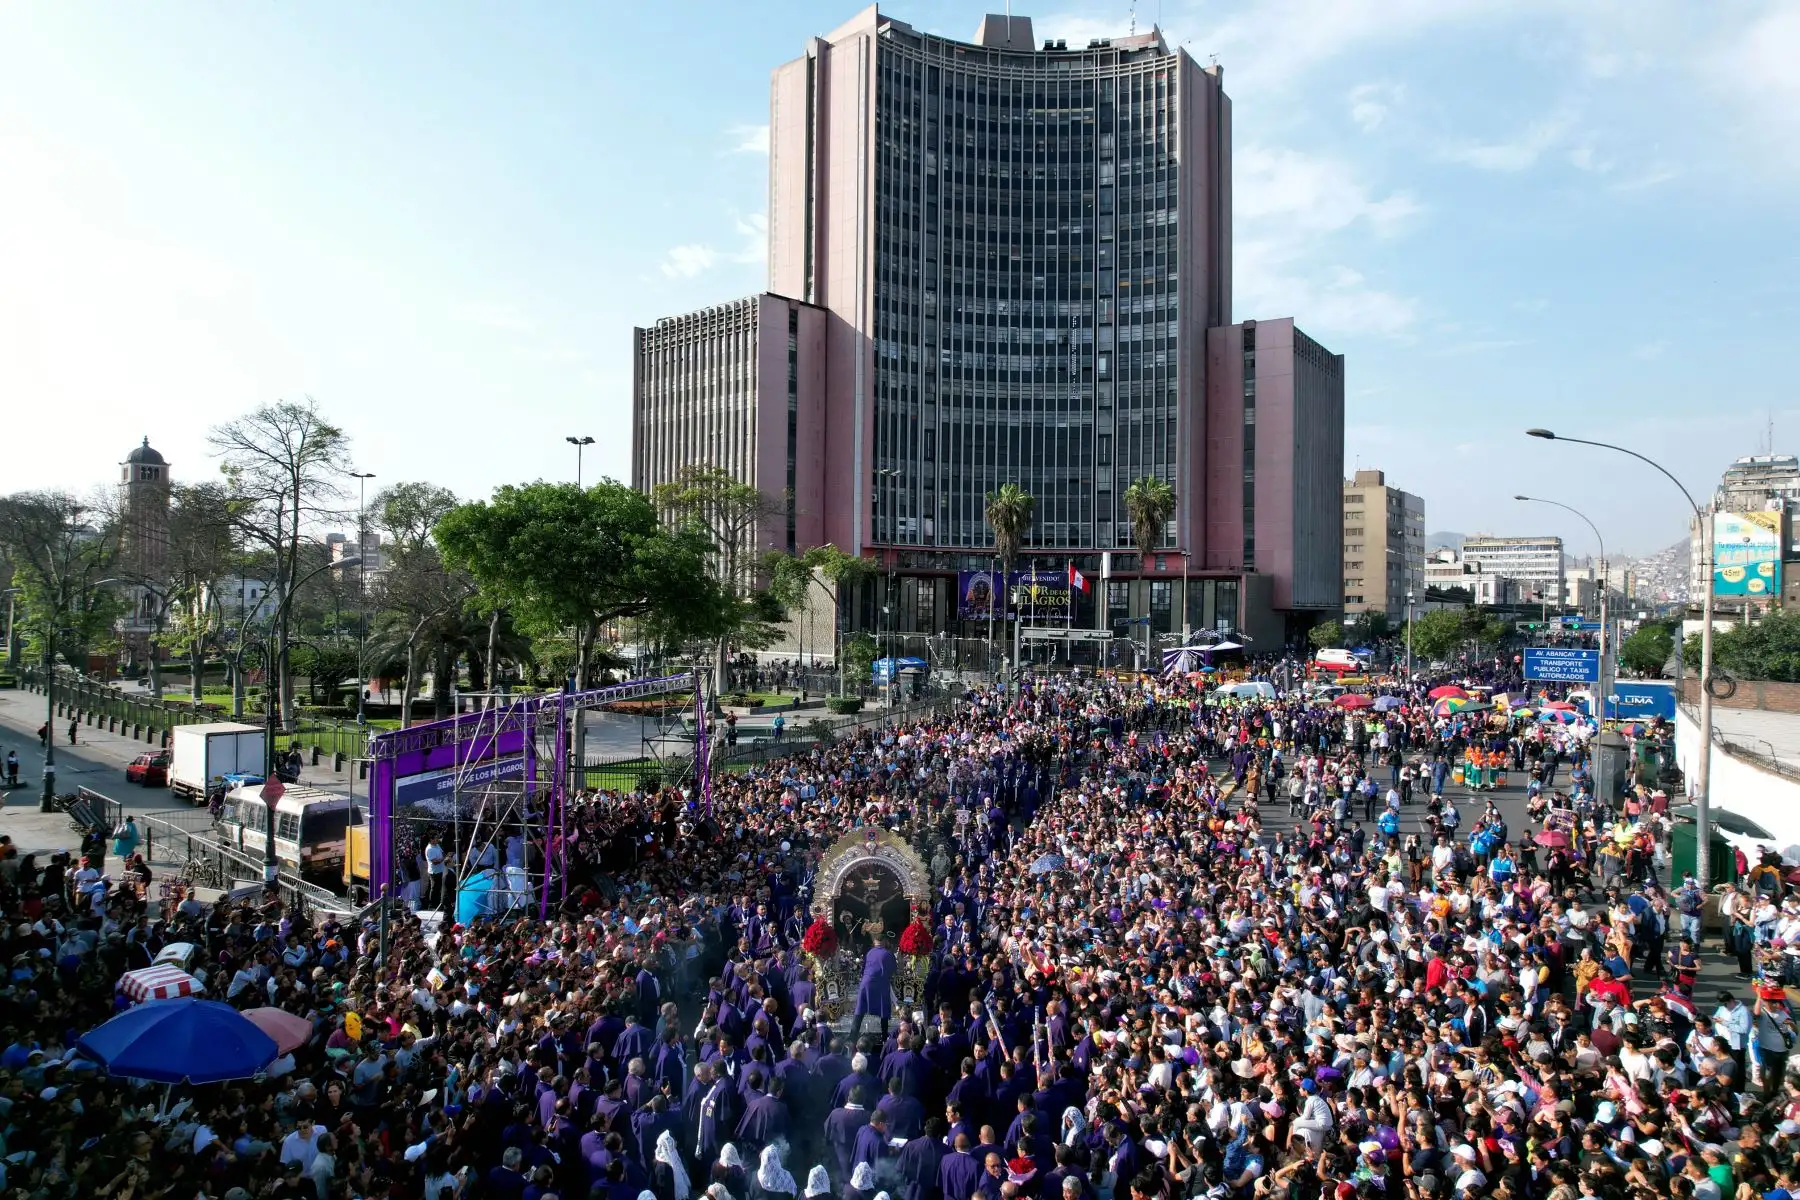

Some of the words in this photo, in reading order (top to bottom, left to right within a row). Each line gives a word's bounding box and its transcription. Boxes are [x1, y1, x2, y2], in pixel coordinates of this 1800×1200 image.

[1624, 697, 1654, 705] LIMA
[436, 776, 464, 790] SEÑO
[475, 770, 490, 781] LOS
[490, 763, 524, 777] MLAGROS
